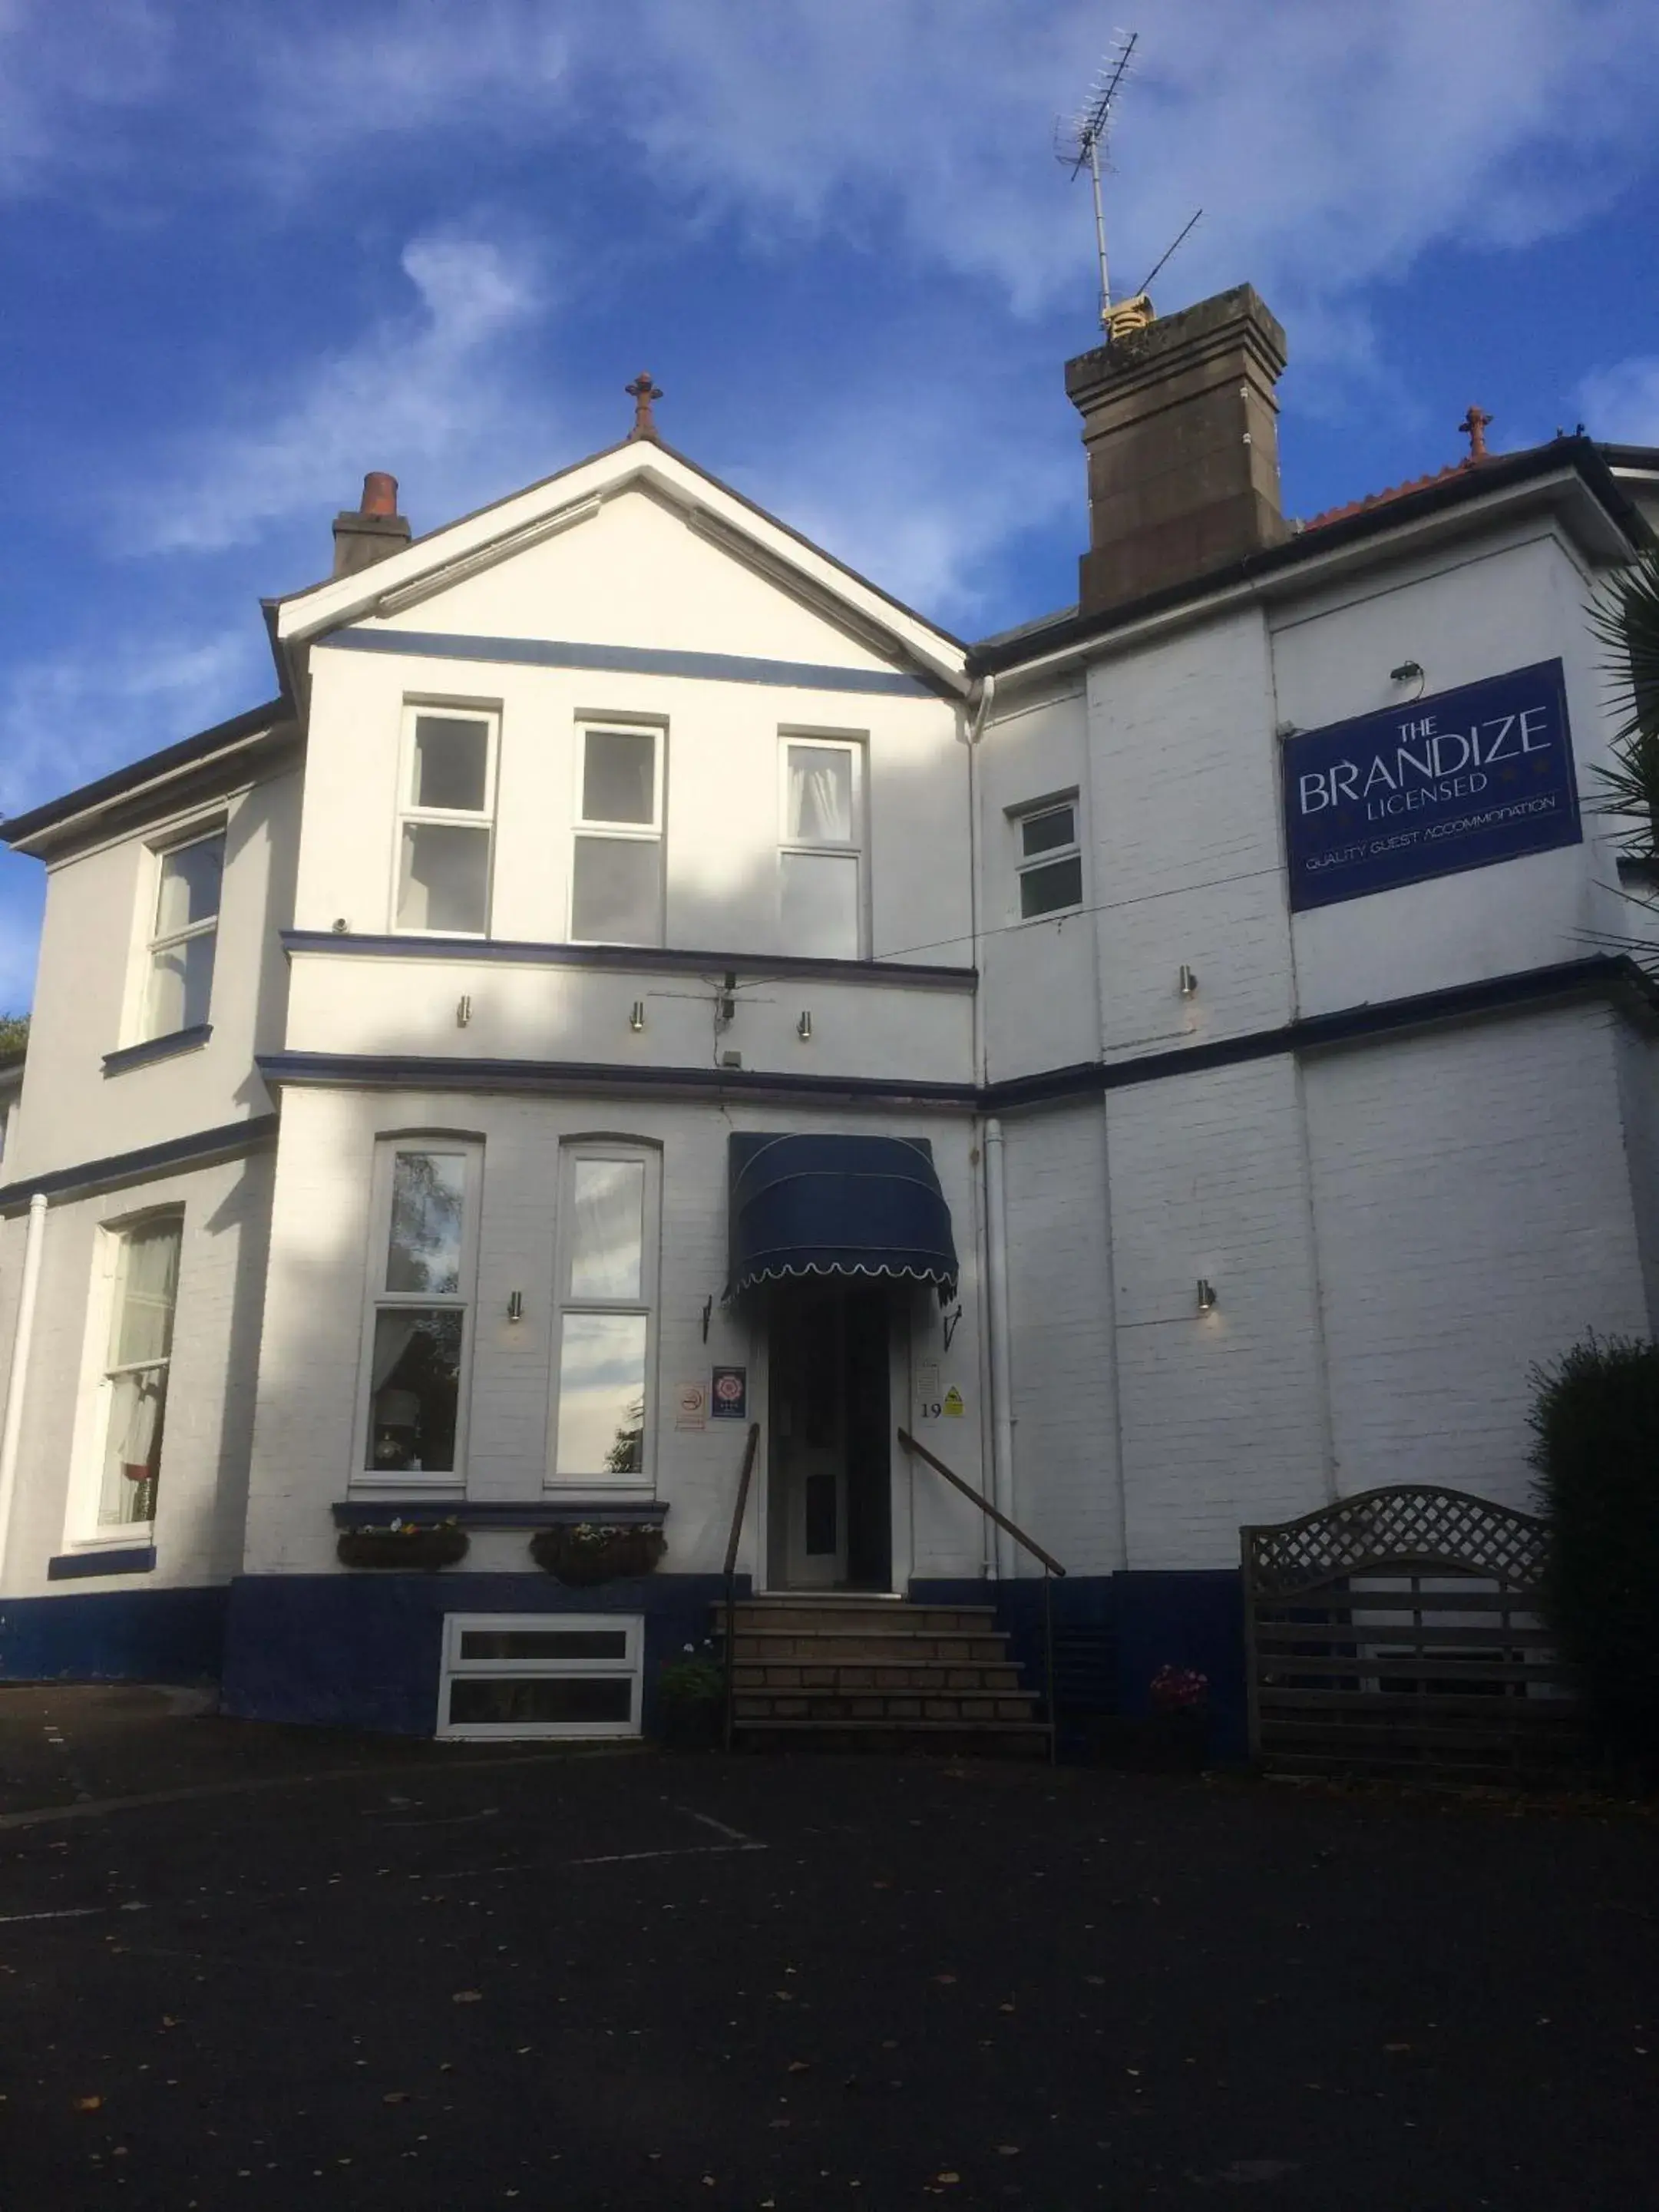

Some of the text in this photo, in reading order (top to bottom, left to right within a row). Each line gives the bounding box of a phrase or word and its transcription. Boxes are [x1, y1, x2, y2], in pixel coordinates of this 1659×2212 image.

[1396, 716, 1437, 742] THE
[1299, 706, 1552, 814] BRANDIZE
[1367, 772, 1488, 820] LICENSED
[1306, 796, 1555, 869] QUALITY GUEST ACCOMMODATION
[921, 1403, 941, 1418] 19
